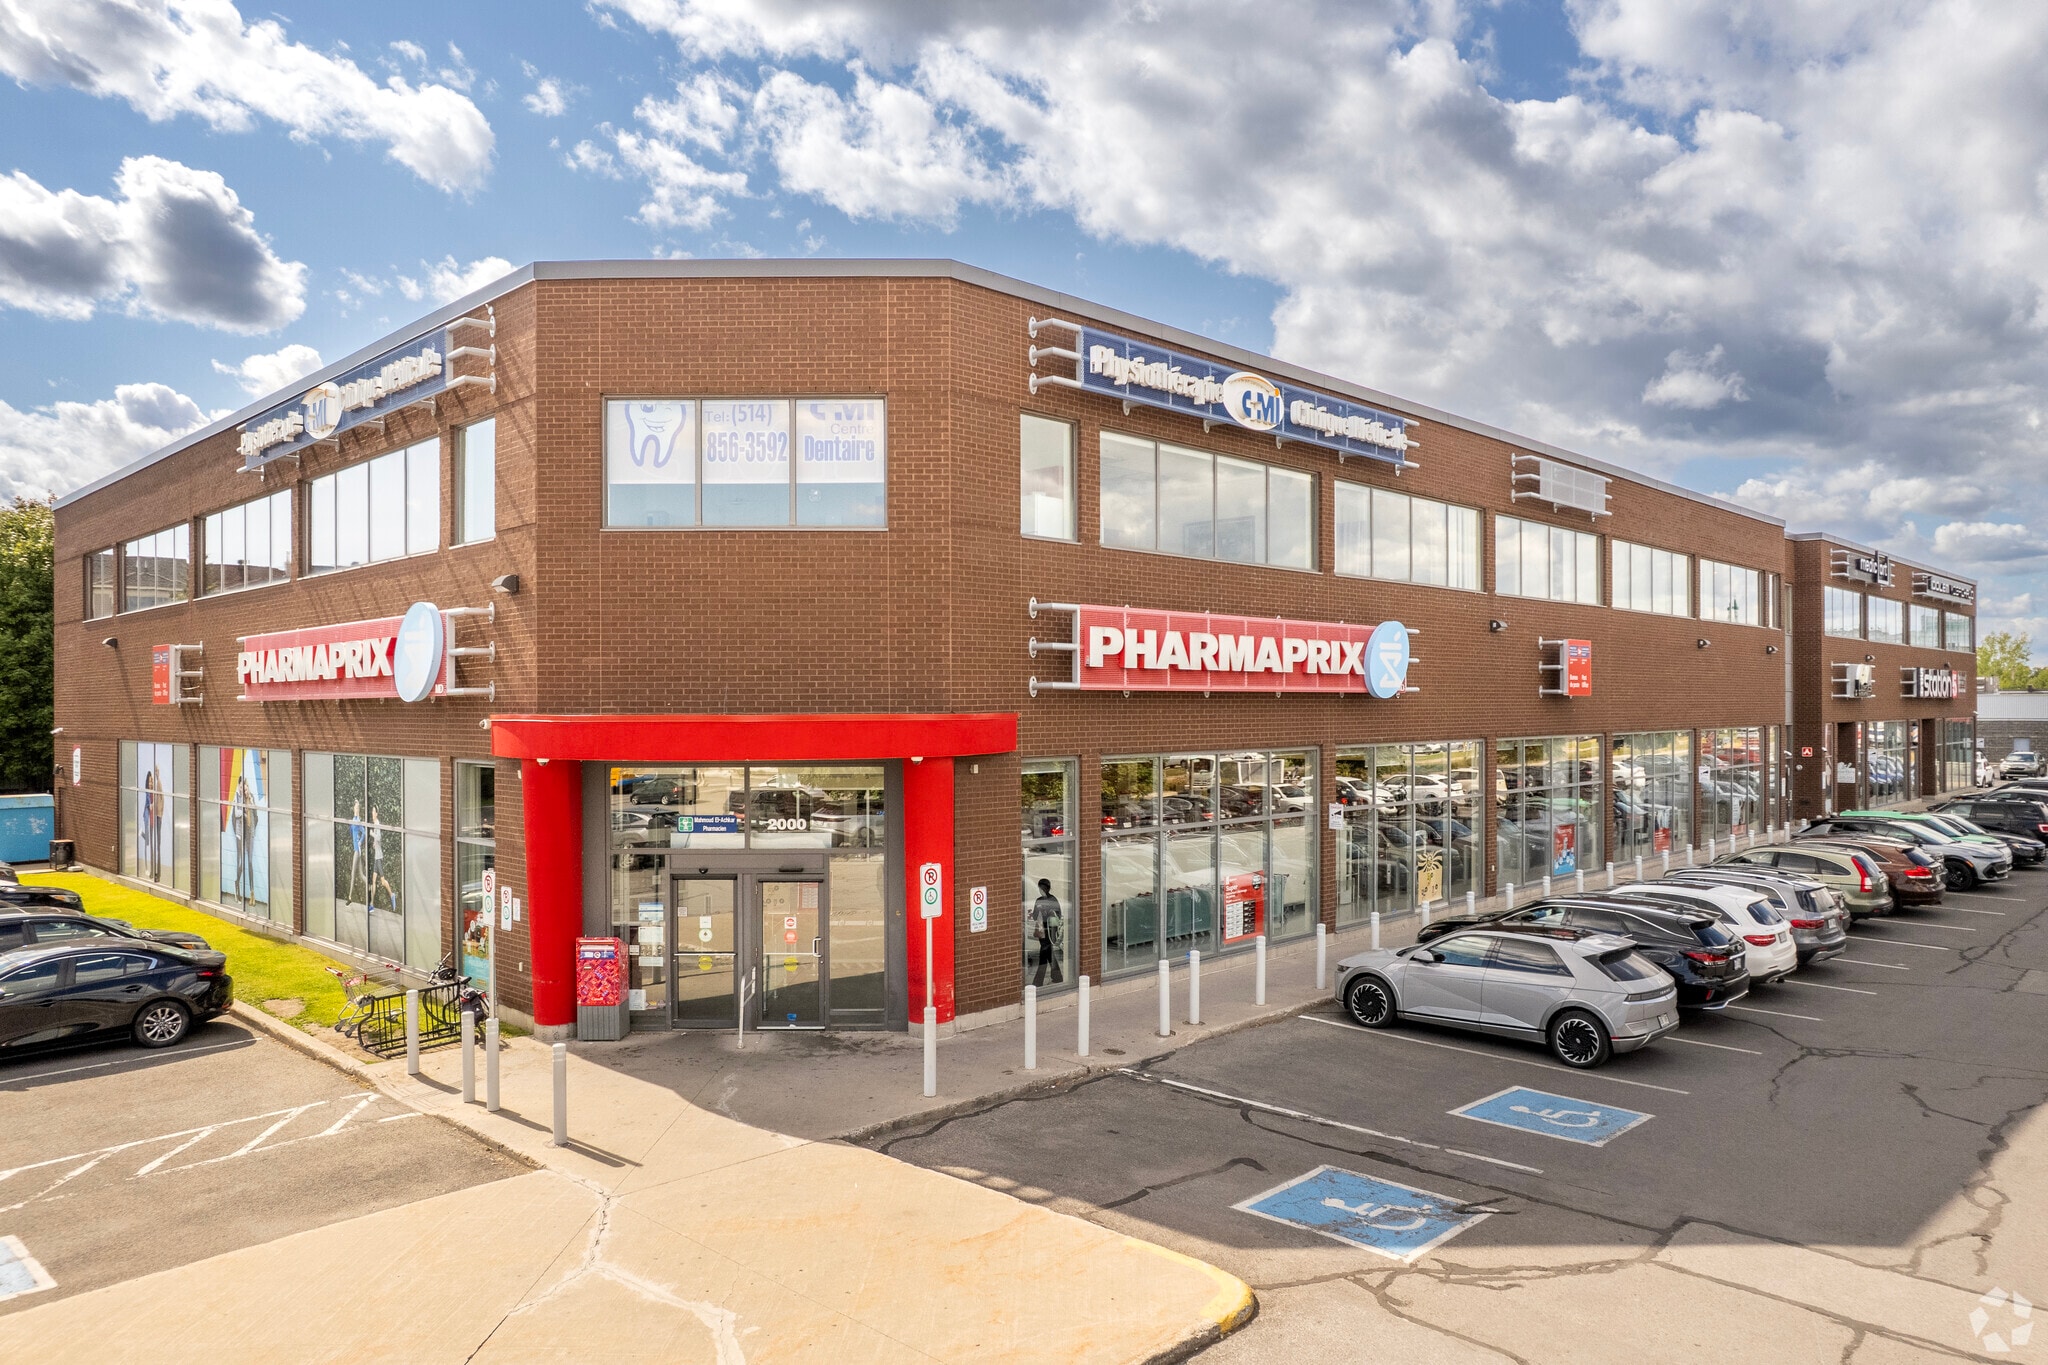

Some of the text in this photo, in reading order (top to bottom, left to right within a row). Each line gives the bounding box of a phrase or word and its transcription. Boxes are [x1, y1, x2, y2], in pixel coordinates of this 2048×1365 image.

[704, 403, 773, 427] Tel: (514)
[830, 423, 874, 435] Centre
[707, 431, 788, 463] 856-3592
[804, 435, 875, 462] Dentaire
[237, 636, 394, 684] PHARMAPRIX
[1088, 625, 1366, 676] PHARMAPRIX
[767, 818, 807, 830] 2000
